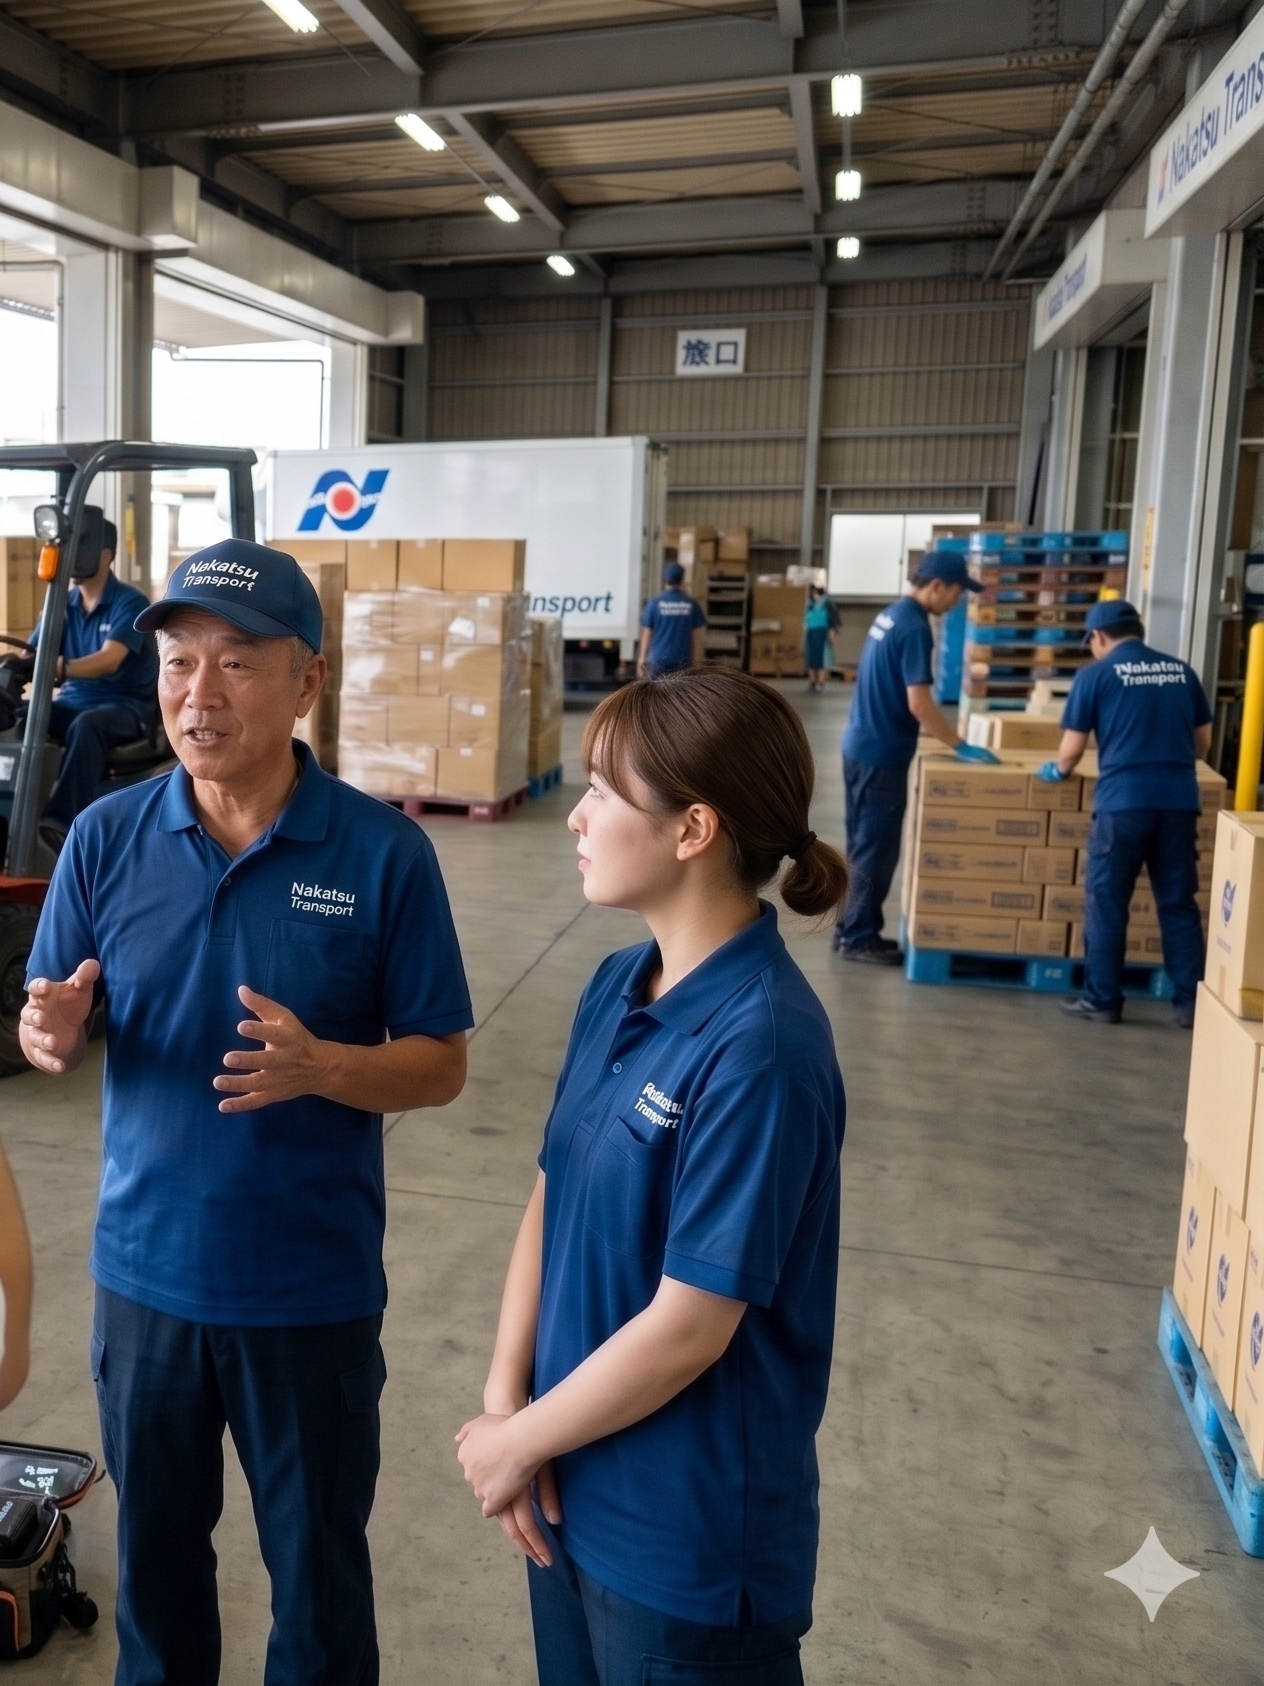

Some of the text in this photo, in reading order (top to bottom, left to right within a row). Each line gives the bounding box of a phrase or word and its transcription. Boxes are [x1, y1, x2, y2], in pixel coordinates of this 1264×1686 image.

[1169, 105, 1221, 193] Nakatsu
[185, 559, 260, 580] Nakatsu
[532, 591, 613, 618] nsport
[291, 881, 356, 904] Nakatsu
[291, 896, 354, 917] Transport
